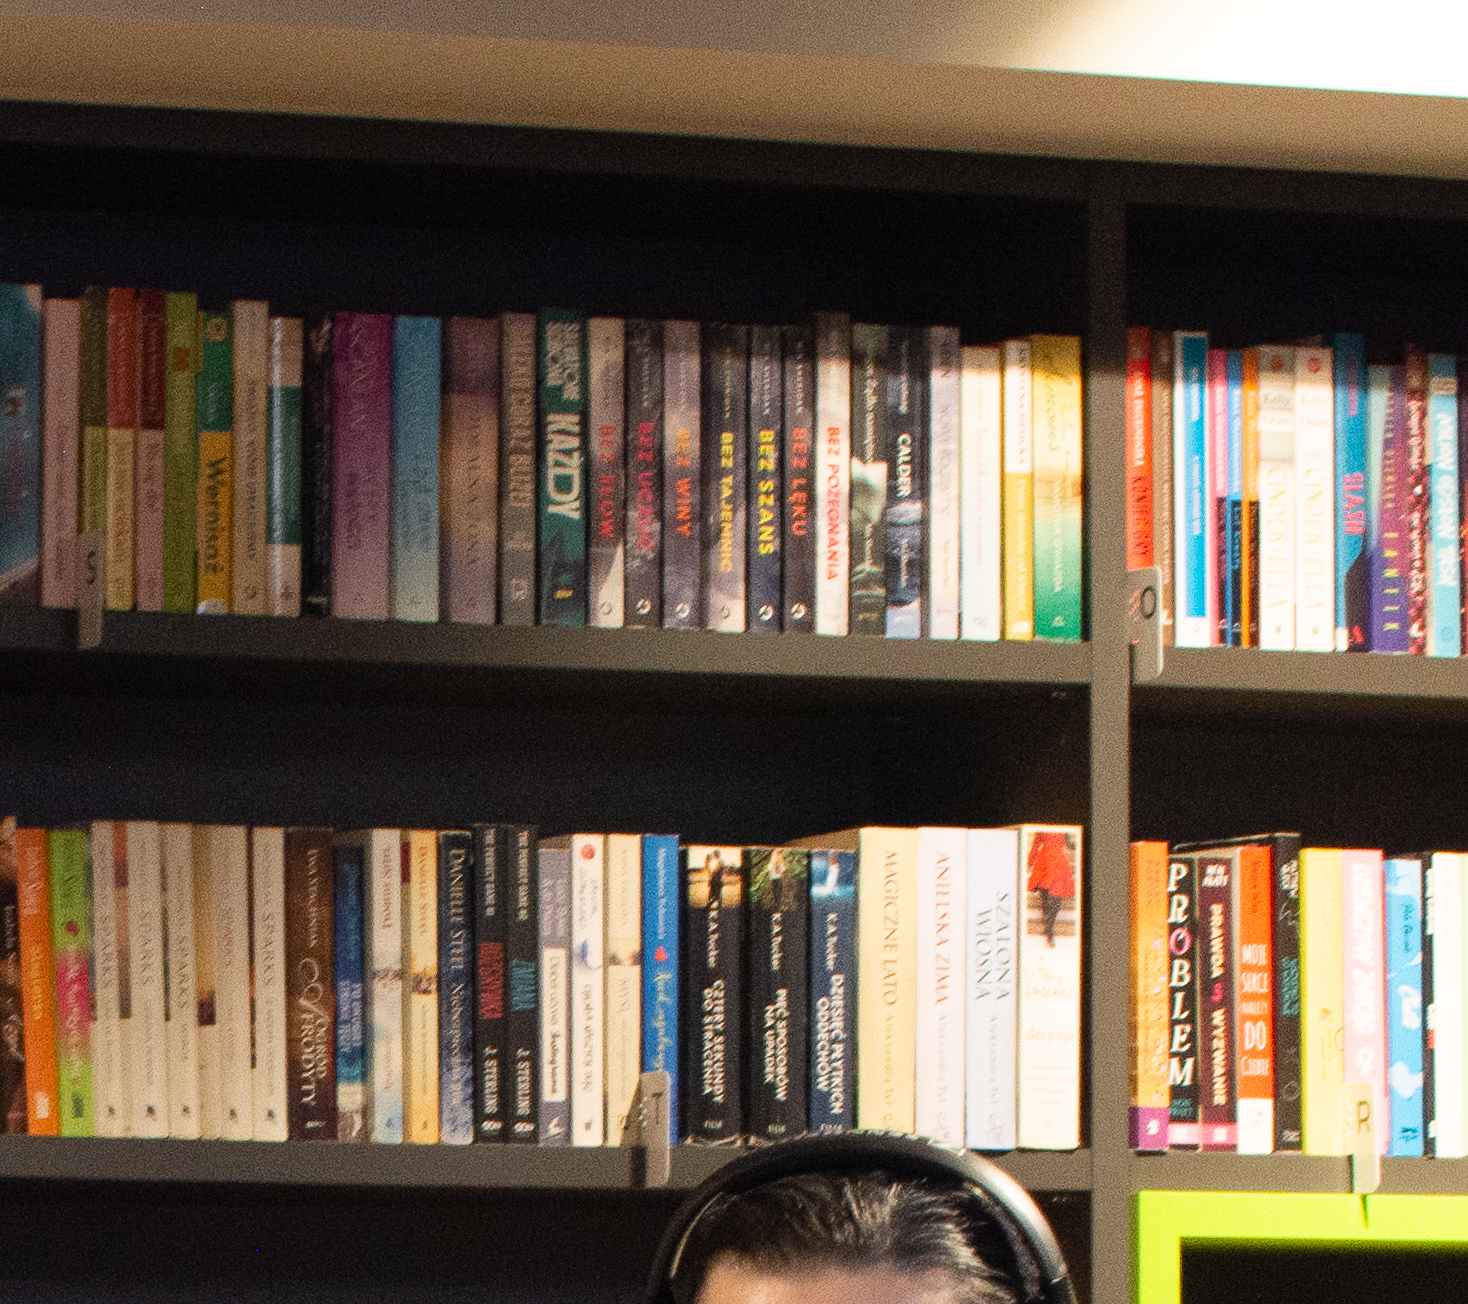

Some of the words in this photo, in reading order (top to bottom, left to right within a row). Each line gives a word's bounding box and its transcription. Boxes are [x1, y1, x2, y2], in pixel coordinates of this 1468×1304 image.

[545, 413, 585, 519] KAŻDY
[676, 428, 691, 469] BEZ
[757, 429, 774, 471] BEZ
[791, 428, 807, 469] BEZ
[826, 426, 841, 457] BEZ
[896, 434, 912, 496] CALDER
[676, 478, 691, 537] WINY
[757, 481, 774, 555] SZANS
[787, 479, 808, 536] LĘKU
[1344, 472, 1364, 534] SLASH
[449, 849, 465, 924] DANIELLE
[882, 851, 898, 950] MAGICZNE
[450, 929, 465, 971] STEEL
[1210, 904, 1225, 978] PRAWDA
[882, 959, 898, 1006] LATO
[484, 1059, 498, 1113] STERLING
[1211, 1009, 1226, 1106] WYZWANIE
